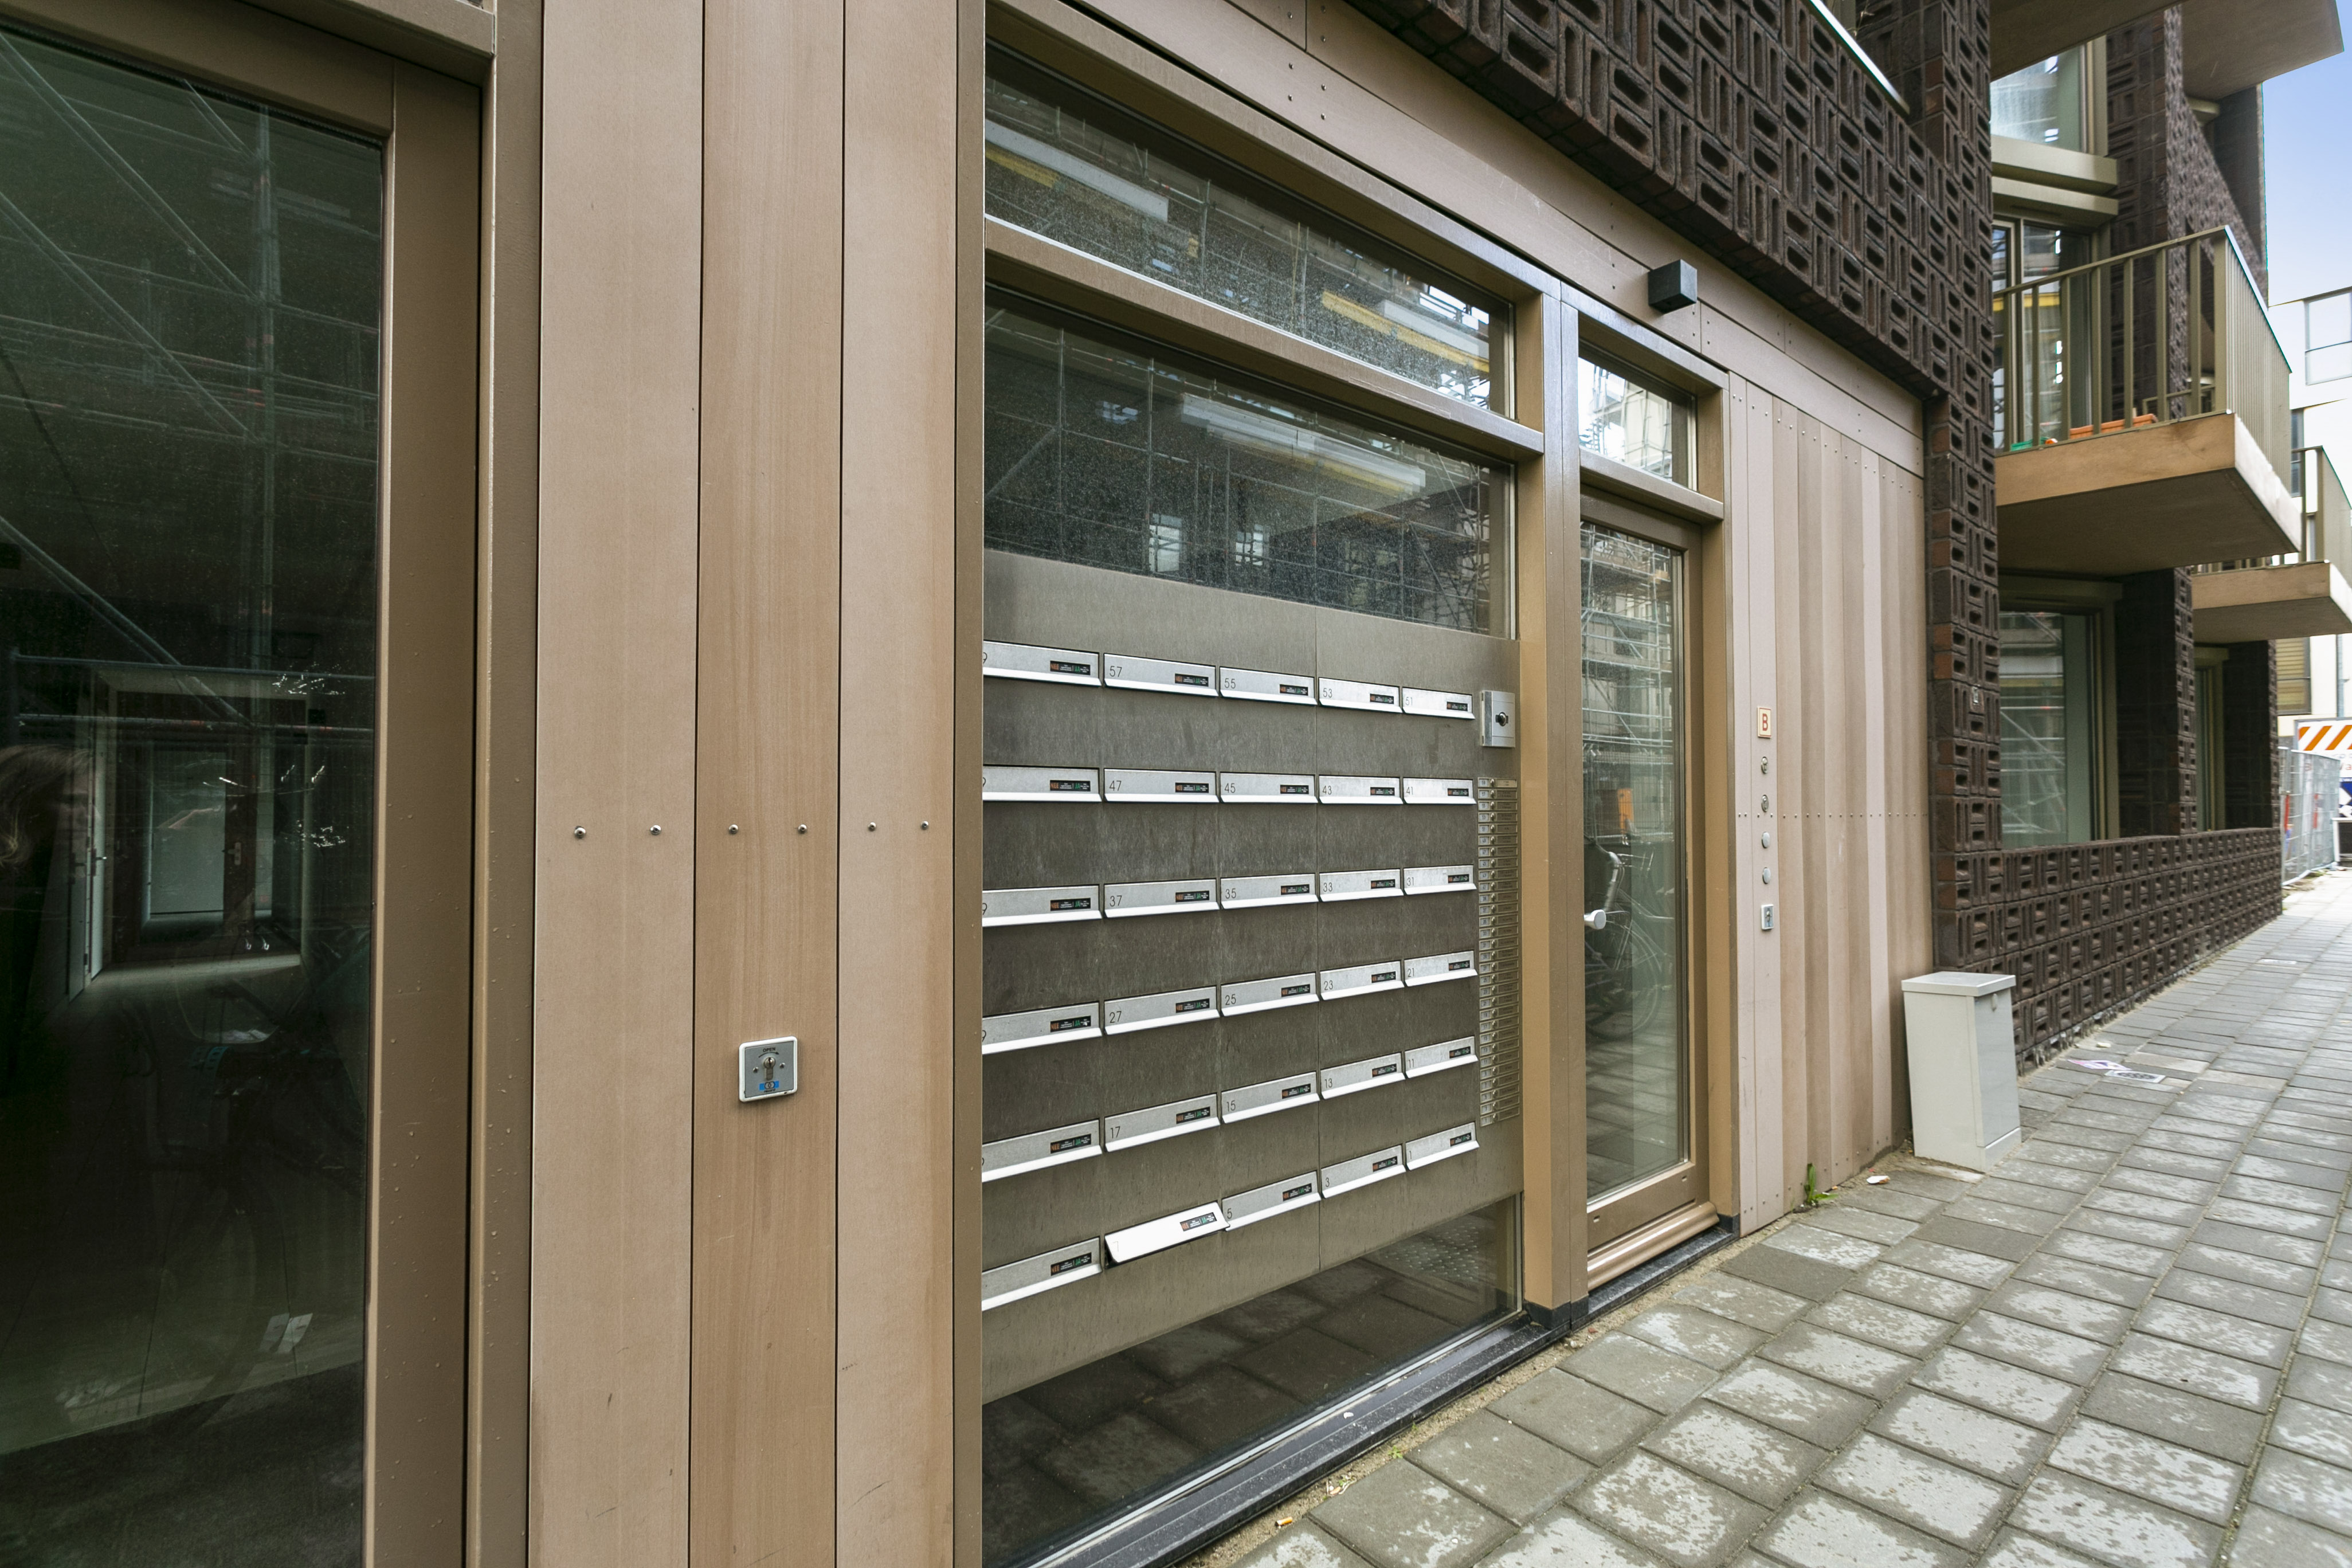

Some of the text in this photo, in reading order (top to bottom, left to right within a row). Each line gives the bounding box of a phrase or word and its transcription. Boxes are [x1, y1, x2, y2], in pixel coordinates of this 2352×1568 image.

[1110, 665, 1122, 677] 57
[1224, 678, 1236, 688] 55
[1323, 688, 1332, 697] 53
[1406, 696, 1413, 705] 51
[1762, 713, 1768, 731] B
[1109, 780, 1122, 791] 47
[1224, 783, 1236, 793] 45
[1322, 785, 1332, 795] 43
[1406, 786, 1413, 795] 41
[1323, 882, 1333, 892] 33
[1407, 877, 1414, 887] 31
[1225, 888, 1236, 899] 35
[1110, 895, 1122, 907] 37
[1408, 967, 1414, 978] 21
[1324, 980, 1333, 991] 23
[1225, 994, 1236, 1005] 25
[1110, 1010, 1122, 1024] 27
[1409, 1059, 1414, 1068] 11
[1324, 1078, 1332, 1088] 13
[1226, 1100, 1236, 1112] 15
[1110, 1126, 1120, 1139] 17
[1326, 1177, 1330, 1187] 3
[1227, 1208, 1232, 1219] 5
